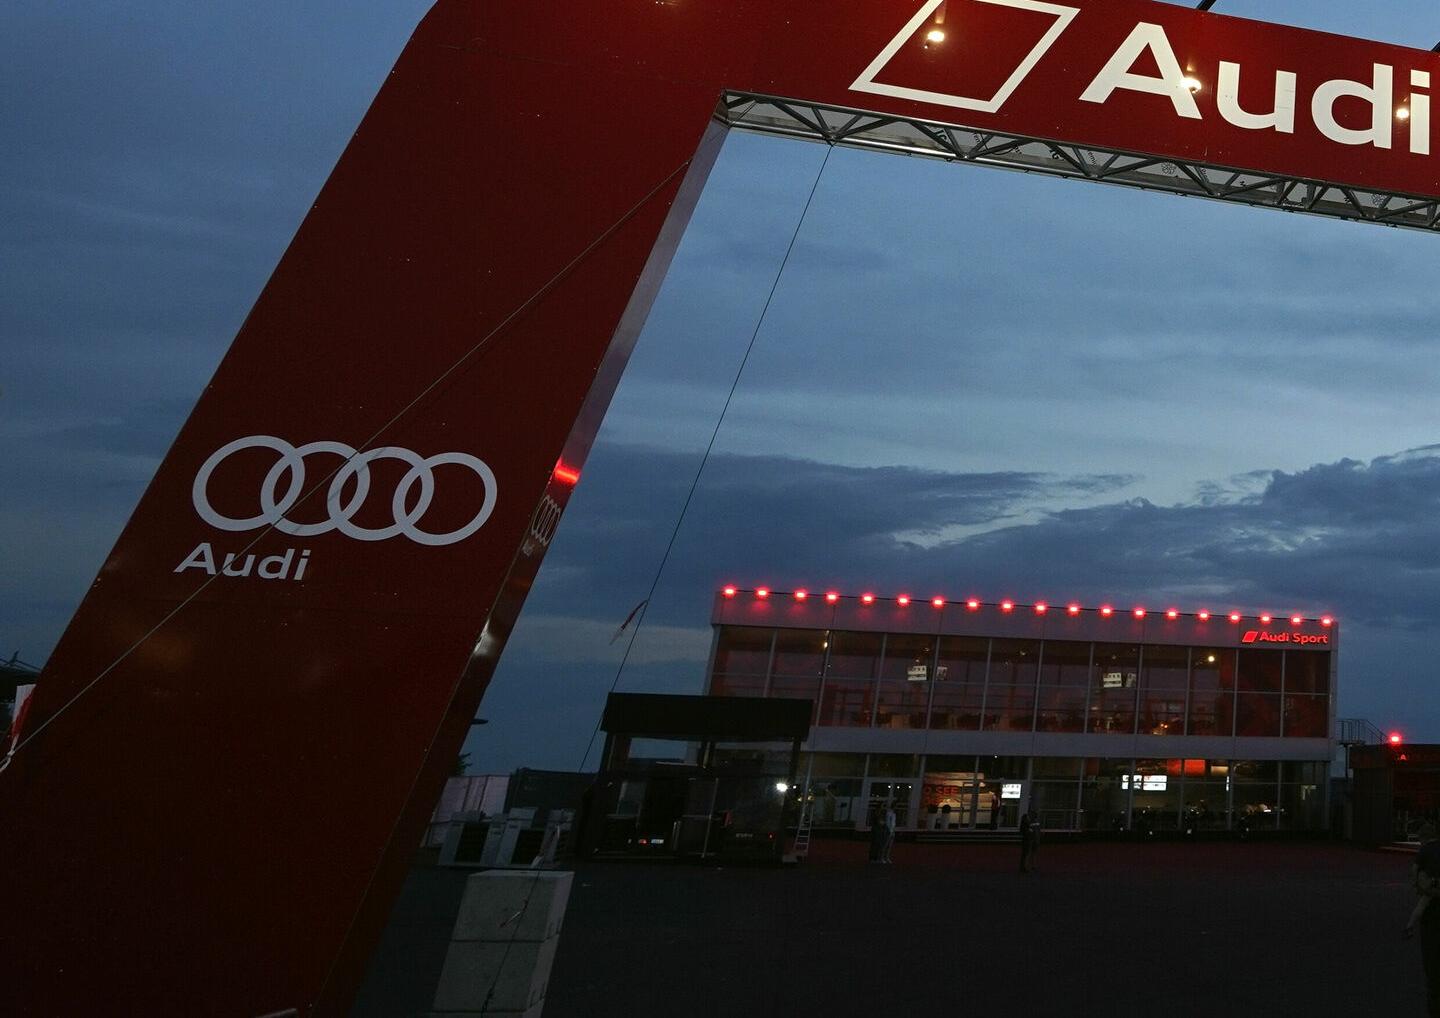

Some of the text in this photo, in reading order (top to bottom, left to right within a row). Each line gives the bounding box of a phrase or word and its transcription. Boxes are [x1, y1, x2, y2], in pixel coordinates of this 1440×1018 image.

[1078, 21, 1431, 155] Audi
[173, 542, 312, 581] Audi
[1259, 631, 1328, 644] Audi Sport
